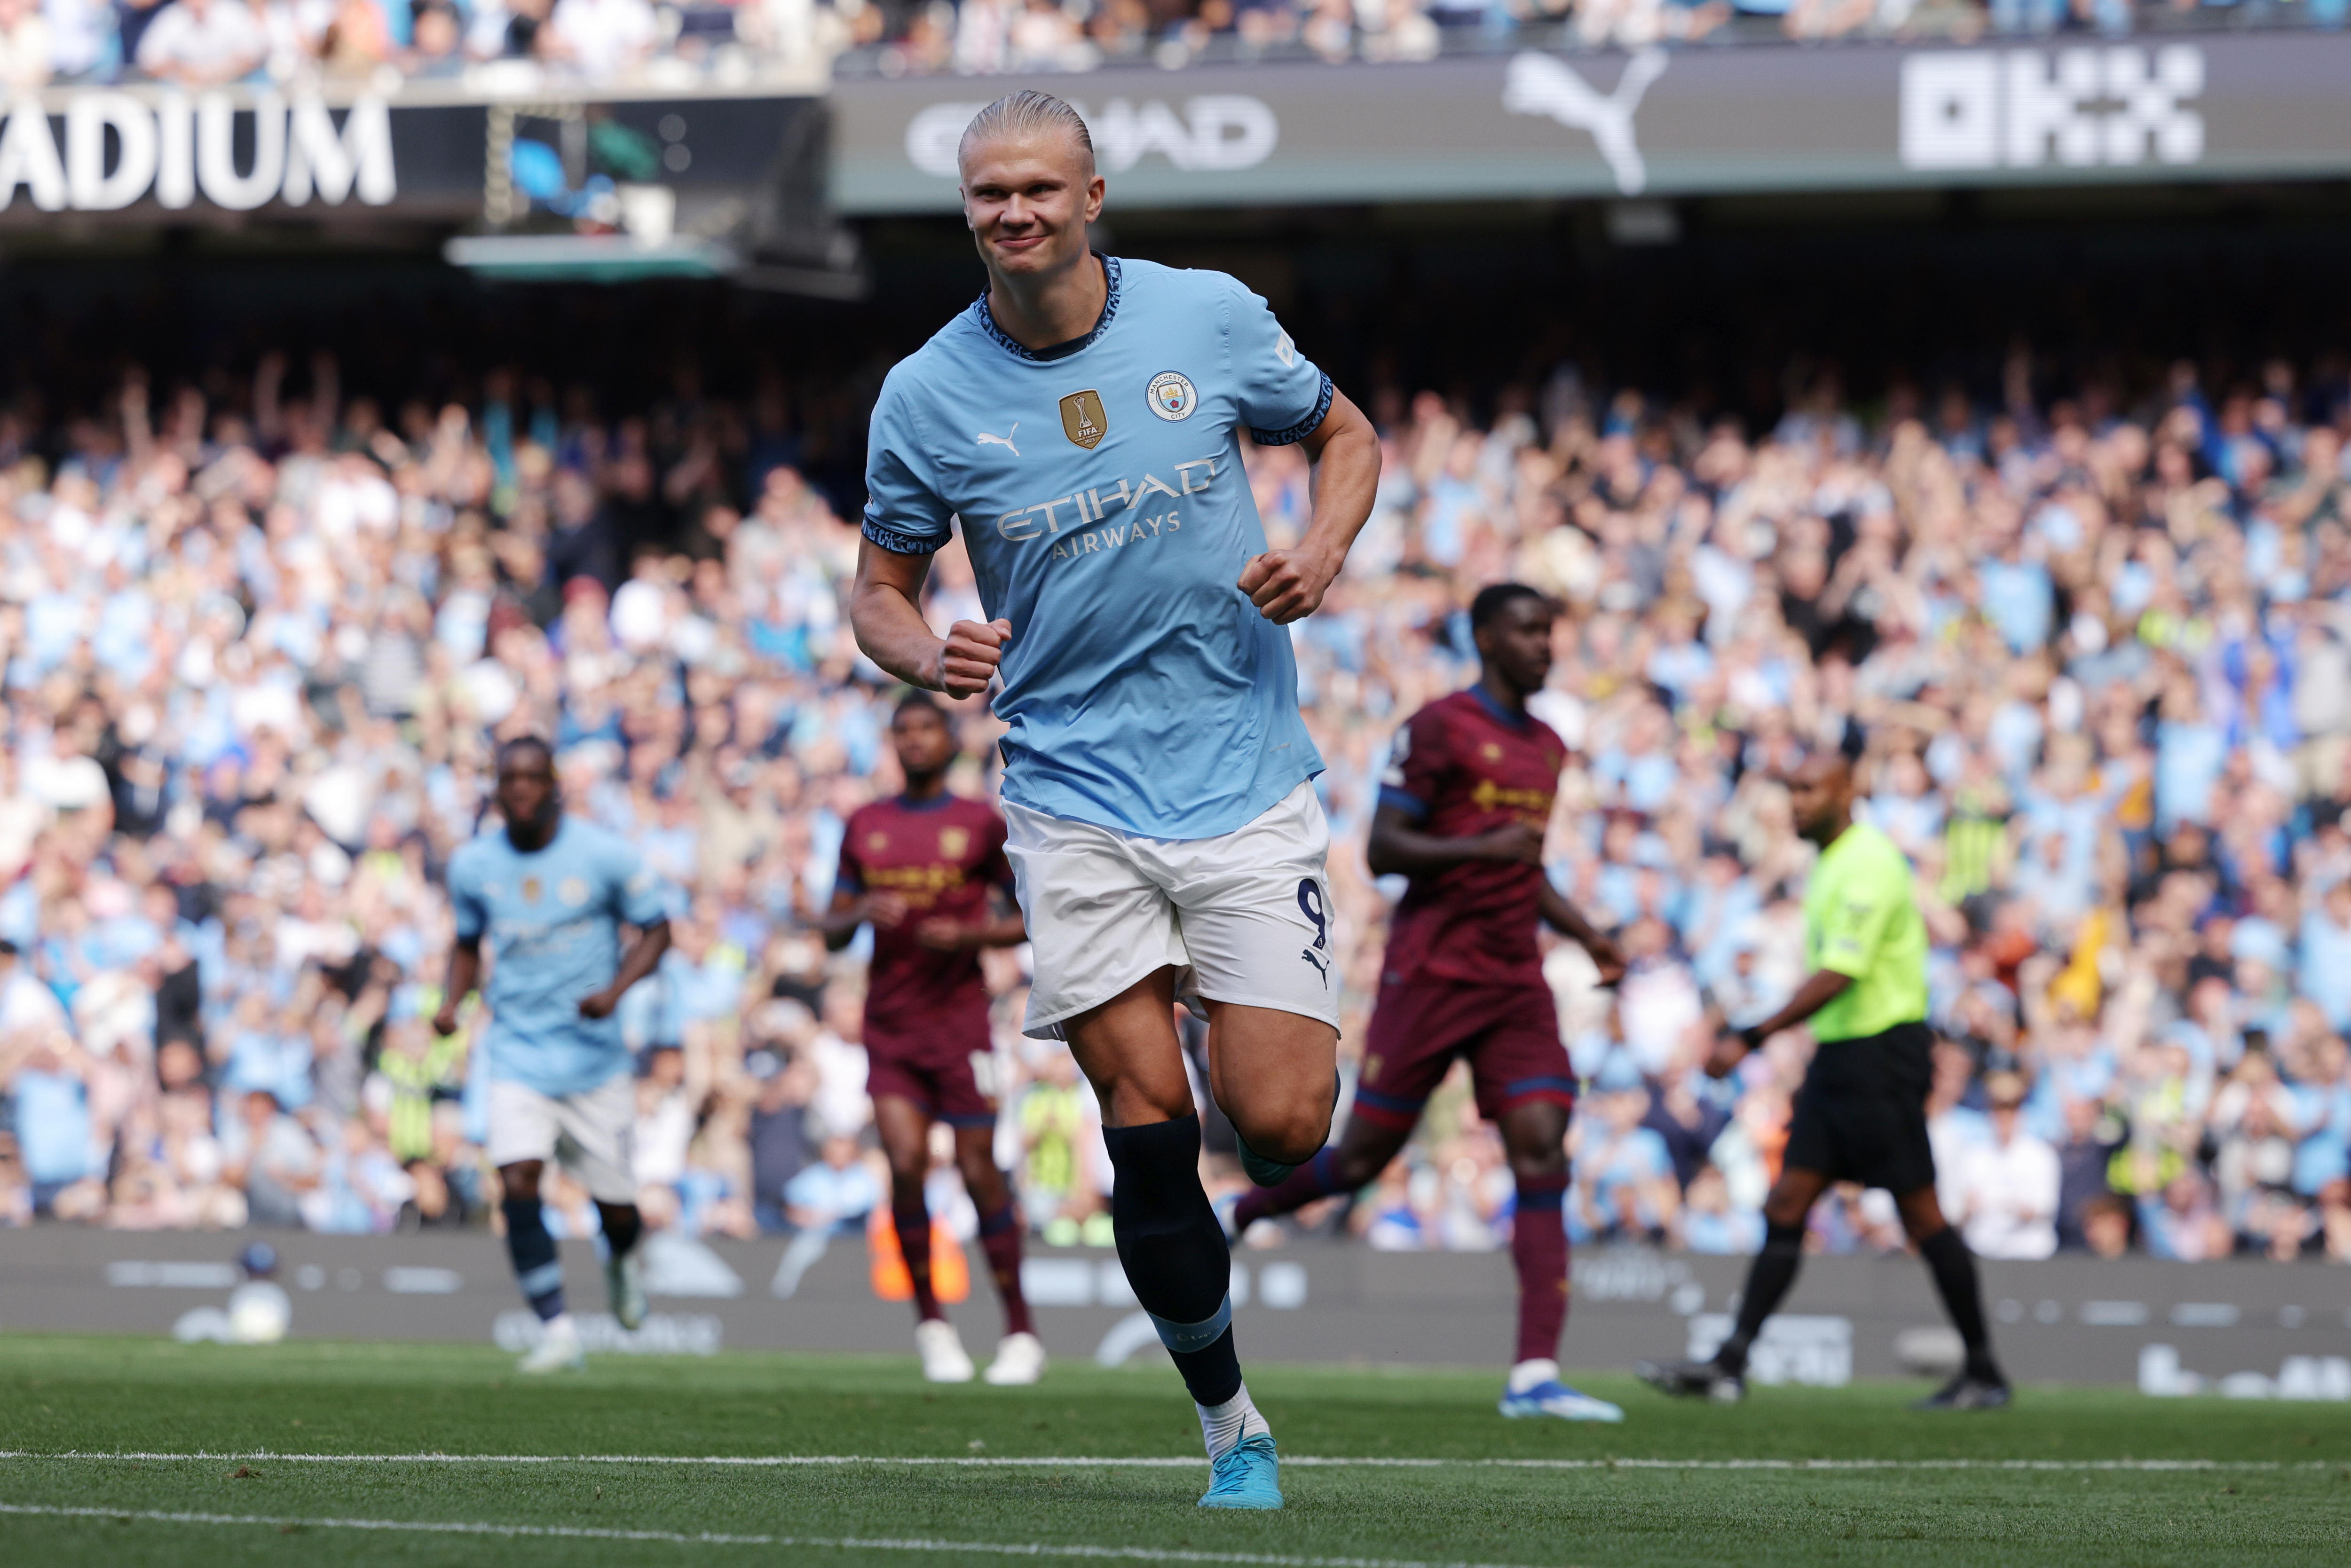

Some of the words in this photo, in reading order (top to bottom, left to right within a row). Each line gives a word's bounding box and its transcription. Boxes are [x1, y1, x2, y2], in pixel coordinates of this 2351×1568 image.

[1900, 46, 2205, 170] OKX
[1150, 375, 1189, 394] MANCHESTER
[1078, 427, 1098, 437] FIFA
[997, 458, 1215, 542] ETIHAD
[1052, 511, 1181, 560] AIRWAYS
[1297, 878, 1326, 950] 9
